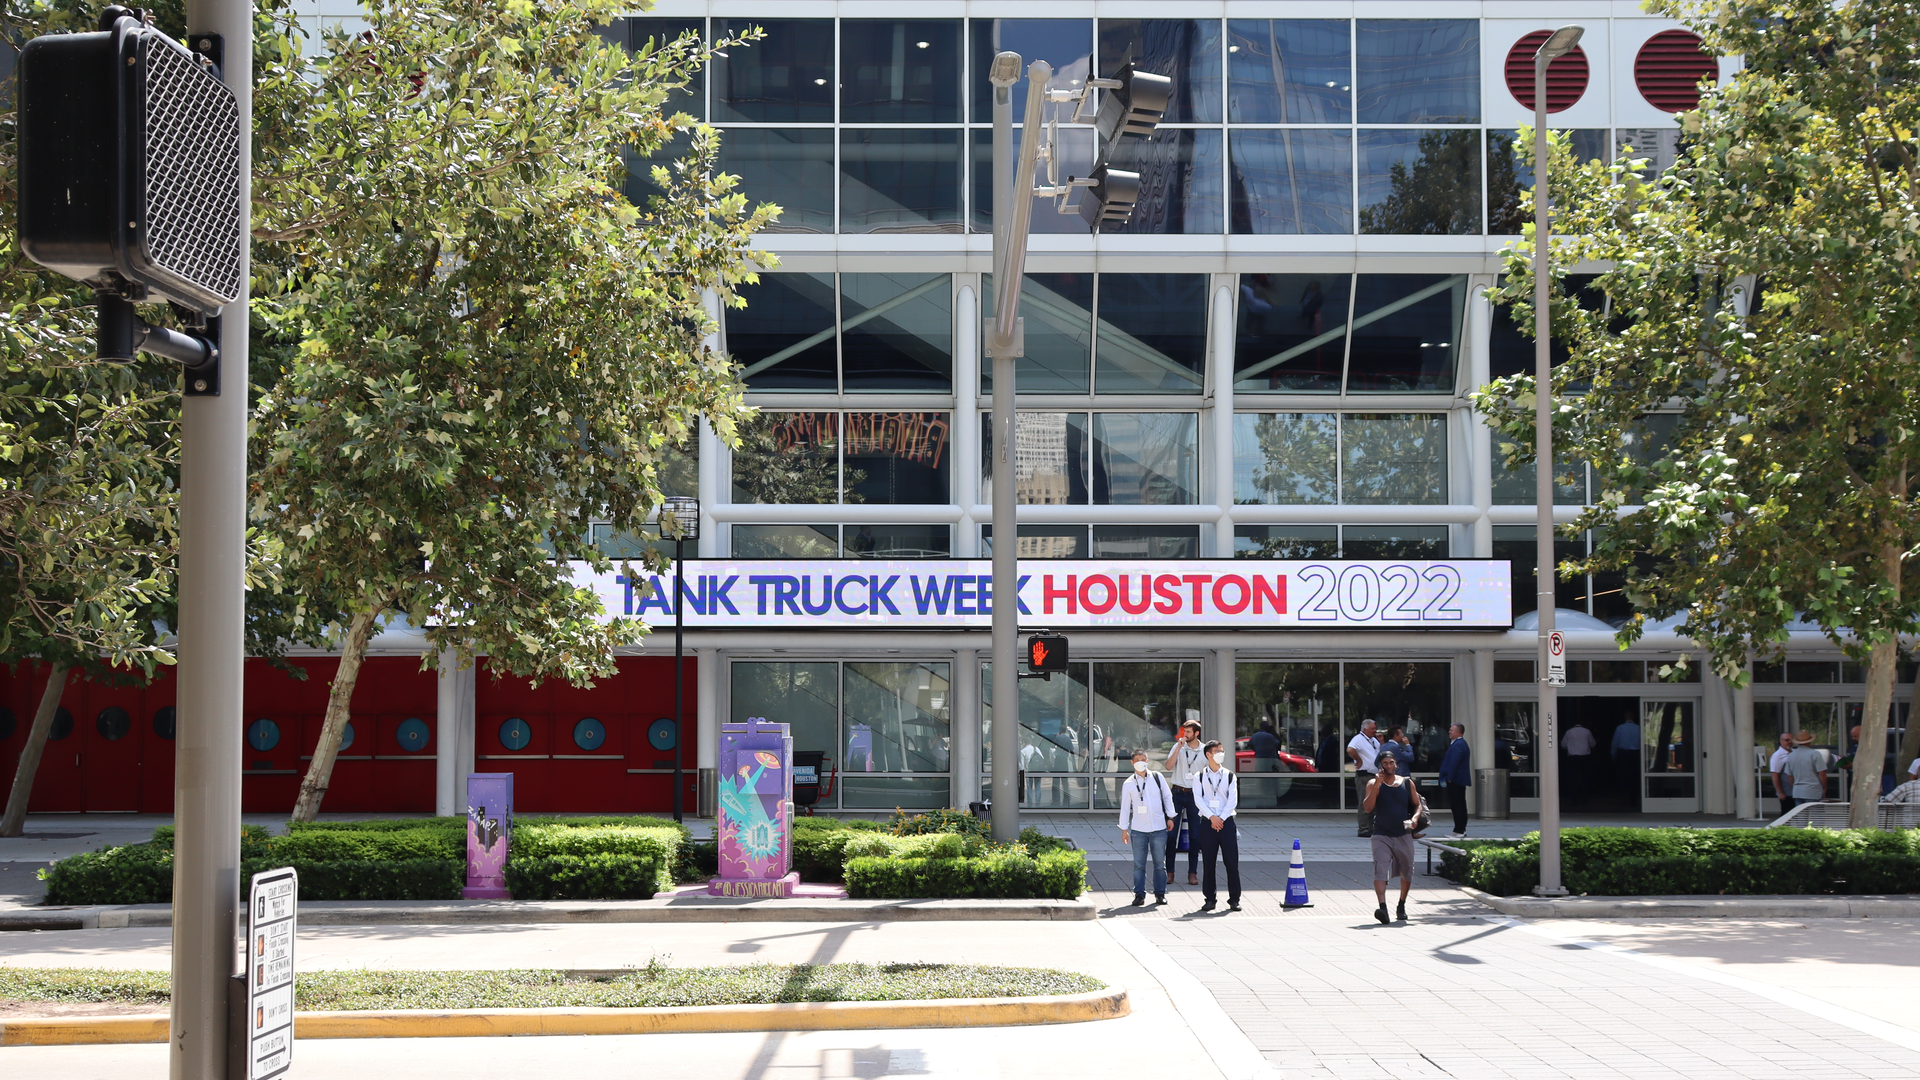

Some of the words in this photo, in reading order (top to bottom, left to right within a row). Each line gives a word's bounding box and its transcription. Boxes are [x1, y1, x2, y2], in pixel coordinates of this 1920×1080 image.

[616, 575, 740, 615] TANK
[750, 575, 901, 614] TRUCK
[1044, 574, 1288, 615] HOUSTON
[1297, 564, 1463, 621] 2022
[260, 1041, 270, 1053] PUSH
[269, 1055, 281, 1069] CROSS
